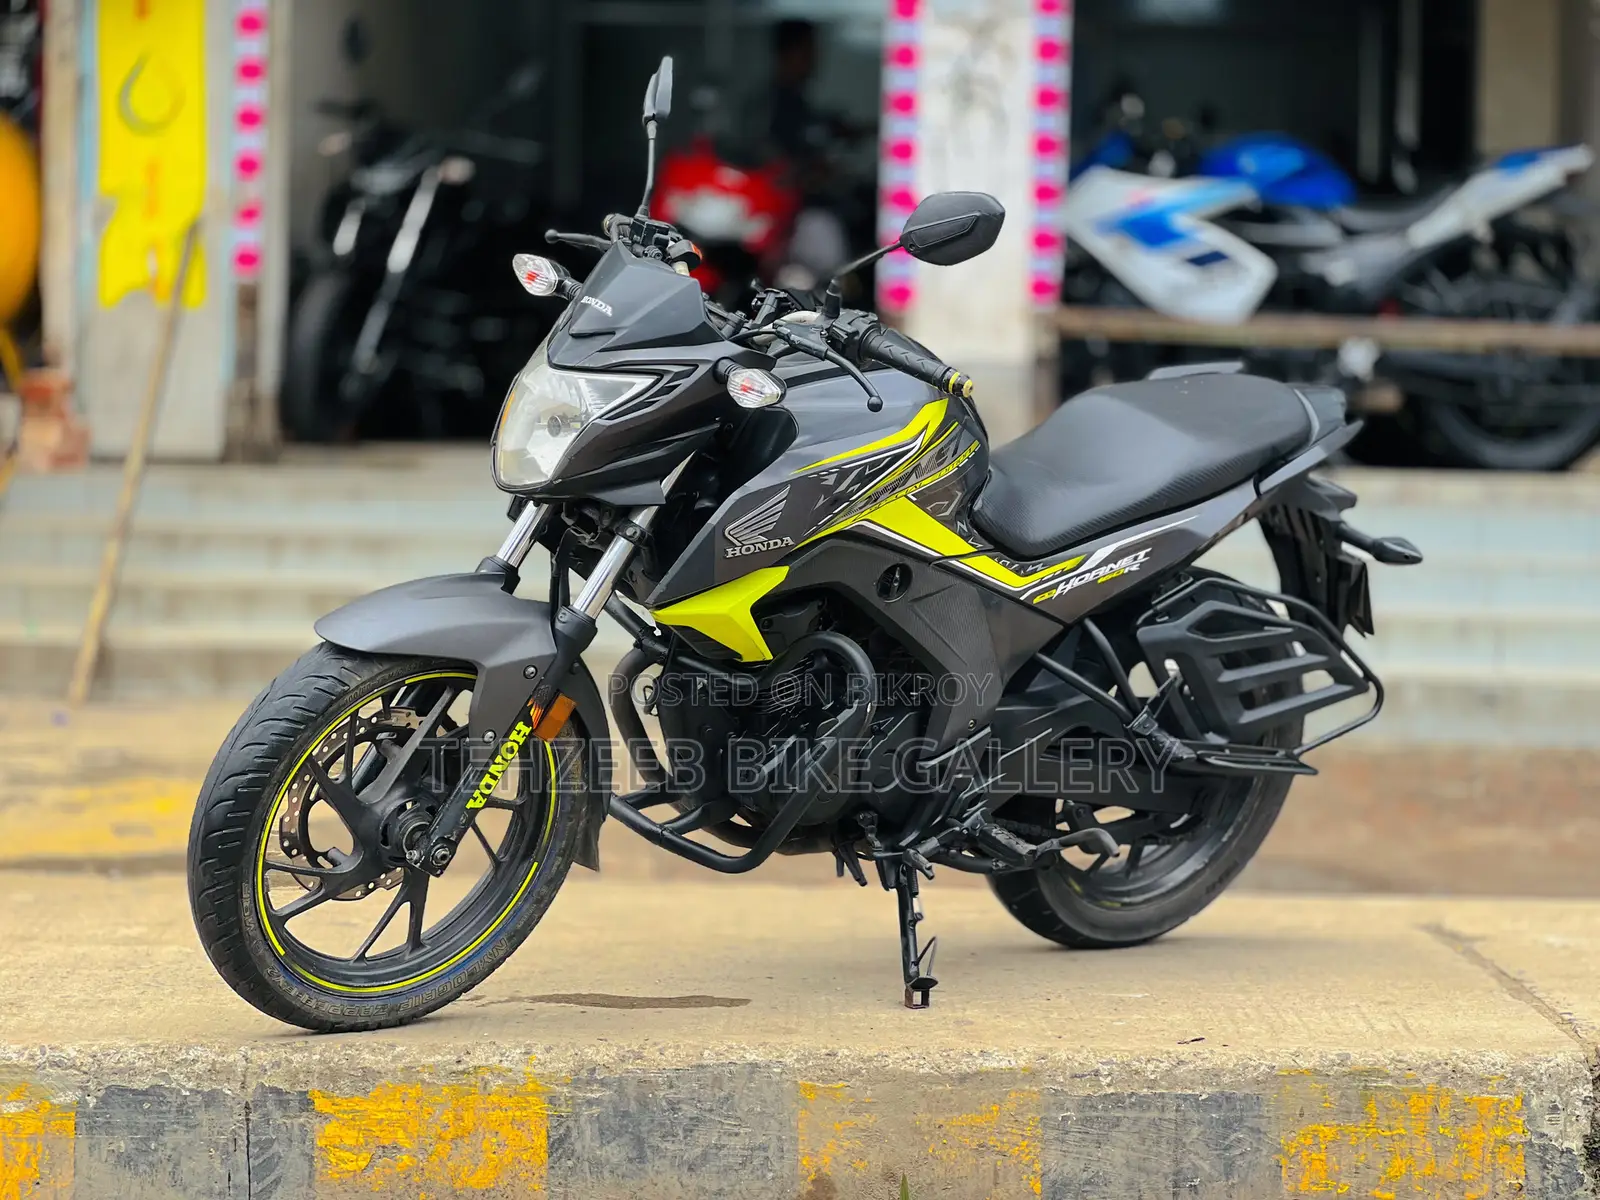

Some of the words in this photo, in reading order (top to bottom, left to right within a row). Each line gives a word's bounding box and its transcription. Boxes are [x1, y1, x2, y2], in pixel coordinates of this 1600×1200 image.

[724, 536, 795, 559] HONDA
[1051, 547, 1153, 600] HORNET
[1096, 562, 1142, 585] 160R
[465, 721, 532, 809] HONDA
[398, 936, 509, 1013] NYLOGRIP
